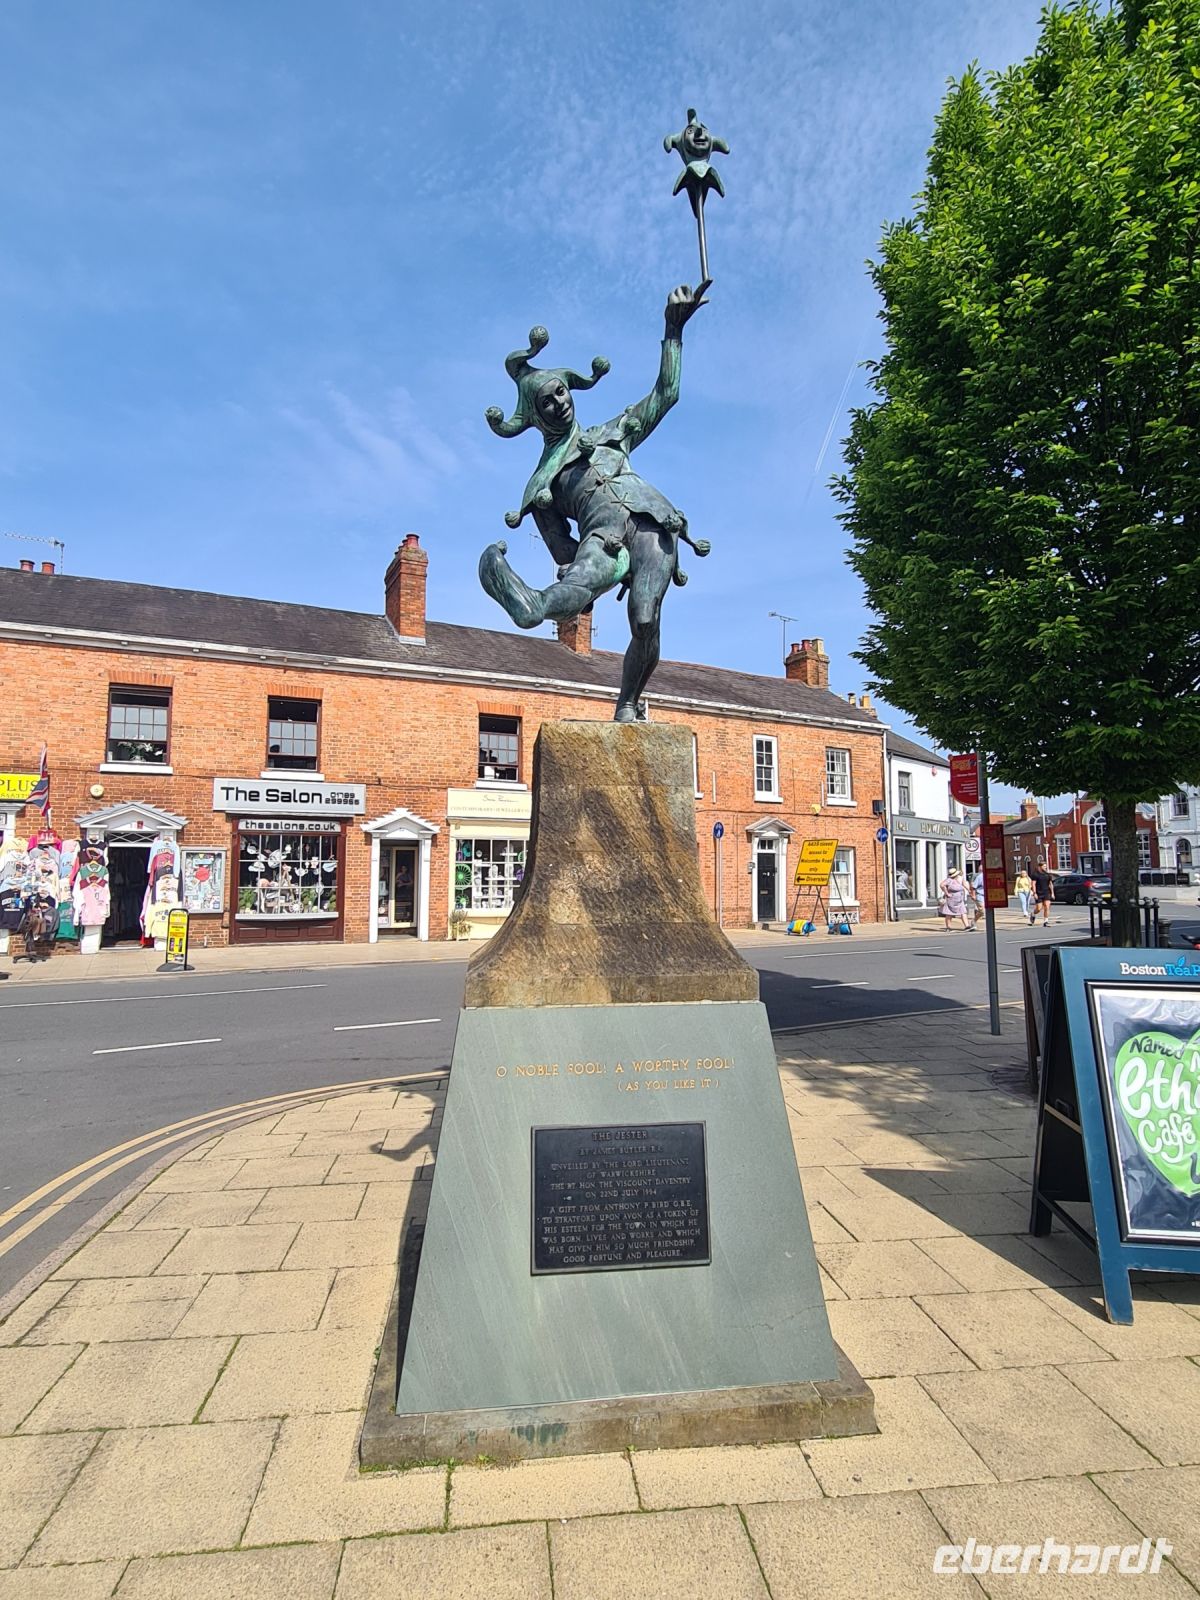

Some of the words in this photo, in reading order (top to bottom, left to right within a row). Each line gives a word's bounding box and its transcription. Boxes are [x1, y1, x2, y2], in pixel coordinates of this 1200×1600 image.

[220, 786, 260, 801] The
[265, 788, 322, 804] Salon
[245, 821, 335, 831] thesalons.co.uk
[967, 841, 978, 849] 30
[496, 1065, 508, 1078] O
[515, 1063, 560, 1077] NOBLE
[567, 1062, 607, 1075] FOOL!
[614, 1063, 624, 1073] A
[632, 1059, 690, 1072] WORTHY
[695, 1057, 735, 1070] FOOL!
[645, 1080, 668, 1090] YOU
[673, 1079, 695, 1089] LIKE
[593, 1131, 611, 1140] THE
[615, 1130, 648, 1140] JESTER
[592, 1147, 616, 1155] JAMES
[619, 1145, 647, 1154] BUTLER
[551, 1162, 589, 1171] UNVEILED
[592, 1161, 601, 1169] BY
[604, 1160, 618, 1168] THE
[623, 1159, 643, 1168] LORD
[645, 1157, 689, 1167] LIEUTENANT
[586, 1171, 596, 1179] OF
[600, 1168, 657, 1178] WARWICKSHIRE
[550, 1182, 565, 1190] THE
[566, 1182, 577, 1190] RT
[579, 1180, 596, 1189] HON
[599, 1180, 613, 1188] THE
[616, 1178, 652, 1187] VISCOUNT
[655, 1176, 691, 1185] DAVENTRY
[585, 1190, 597, 1199] ON
[600, 1189, 619, 1198] 22ND
[621, 1188, 640, 1197] JULY
[643, 1187, 657, 1196] 1994
[549, 1206, 556, 1214] A
[558, 1205, 577, 1213] GIFT
[579, 1203, 601, 1212] FROM
[603, 1202, 641, 1211] ANTHONY
[651, 1200, 669, 1209] BIRD
[541, 1216, 553, 1224] TO
[554, 1214, 596, 1224] STRATFORD
[600, 1212, 621, 1221] UPON
[624, 1211, 643, 1220] AVON
[646, 1210, 655, 1219] AS
[656, 1210, 662, 1218] A
[664, 1209, 688, 1217] TOKEN
[689, 1208, 700, 1216] OF
[543, 1226, 558, 1234] HIS
[561, 1225, 588, 1233] ESTEEM
[591, 1224, 605, 1232] FOR
[625, 1221, 647, 1230] TOWN
[649, 1220, 659, 1228] IN
[660, 1219, 685, 1228] WHICH
[688, 1218, 698, 1226] HE
[542, 1236, 558, 1244] WAS
[586, 1233, 607, 1242] LIVES
[611, 1232, 627, 1240] AND
[629, 1231, 655, 1239] WORKS
[658, 1230, 673, 1238] AND
[675, 1228, 701, 1237] WHICH
[549, 1246, 565, 1255] HAS
[568, 1245, 593, 1253] GIVEN
[596, 1243, 611, 1252] HIM
[614, 1242, 625, 1250] SO
[627, 1241, 650, 1250] MUCH
[563, 1255, 586, 1264] GOOD
[588, 1253, 623, 1262] FORTUNE
[626, 1251, 642, 1260] AND
